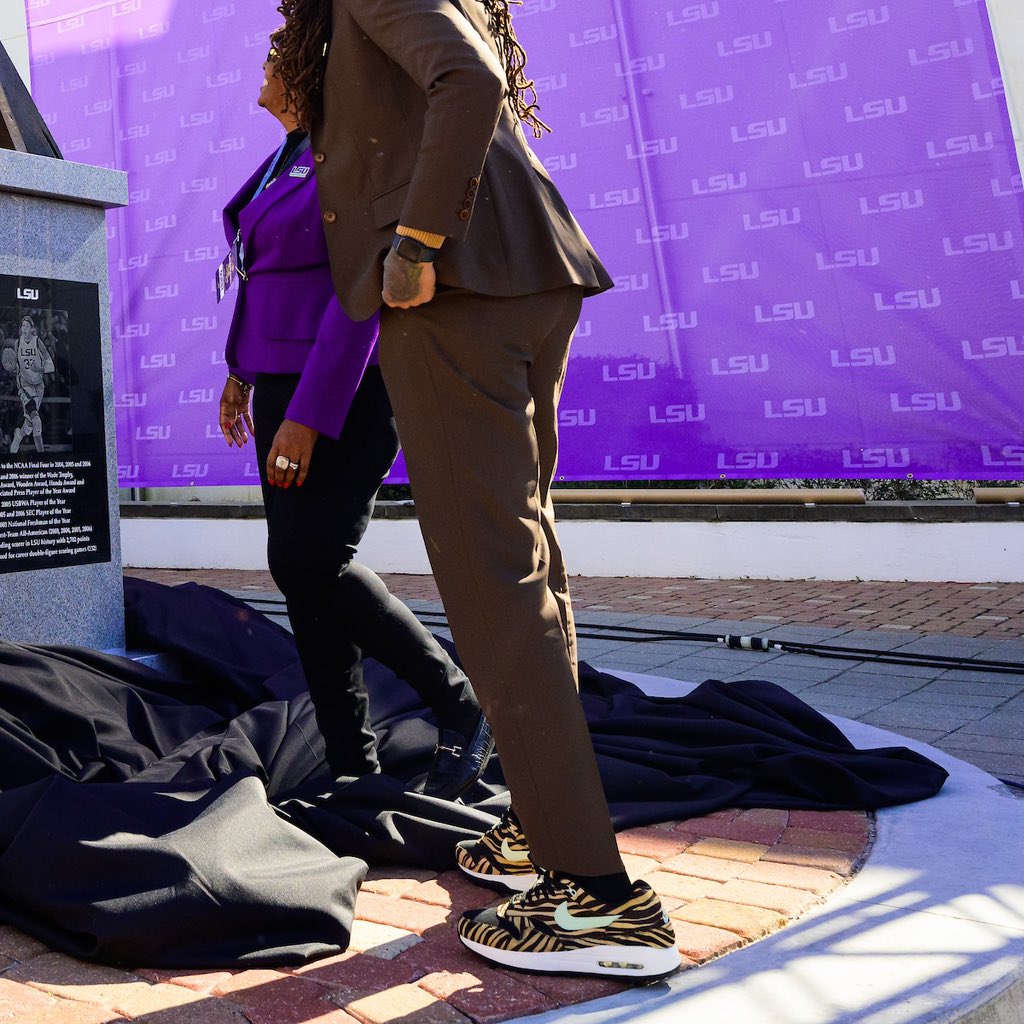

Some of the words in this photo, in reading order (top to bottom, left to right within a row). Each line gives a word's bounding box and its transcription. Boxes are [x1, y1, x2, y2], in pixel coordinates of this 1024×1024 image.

[667, 1, 719, 26] LSU
[139, 20, 168, 39] LSU
[569, 25, 616, 47] LSU
[178, 45, 210, 63] LSU
[908, 38, 974, 65] LSU
[61, 76, 88, 92] LSU
[679, 85, 733, 109] LSU
[85, 100, 112, 115] LSU
[580, 105, 628, 127] LSU
[209, 137, 245, 153] LSU
[926, 132, 993, 159] LSU
[291, 166, 309, 174] LSU
[181, 177, 217, 193] LSU
[692, 172, 746, 194] LSU
[860, 189, 924, 214] LSU
[943, 231, 1013, 256] LSU
[184, 246, 218, 262] LSU
[816, 247, 880, 270] LSU
[703, 262, 759, 283] LSU
[17, 288, 39, 300] LSU
[145, 284, 178, 300] LSU
[874, 288, 941, 310] LSU
[755, 301, 815, 322] LSU
[20, 348, 37, 357] LSU
[141, 354, 175, 368] LSU
[831, 346, 896, 366] LSU
[603, 363, 656, 381] LSU
[764, 398, 826, 418] LSU
[891, 392, 961, 412] LSU
[650, 404, 705, 423] LSU
[136, 426, 170, 439] LSU
[605, 454, 660, 470] LSU
[717, 453, 778, 468] LSU
[844, 448, 909, 466] LSU
[26, 488, 39, 497] Player
[30, 499, 43, 507] Player
[36, 509, 49, 517] Player
[19, 529, 48, 537] All-American
[41, 538, 55, 546] history
[77, 535, 90, 544] points
[29, 549, 58, 557] double-figure
[59, 547, 73, 555] scoring
